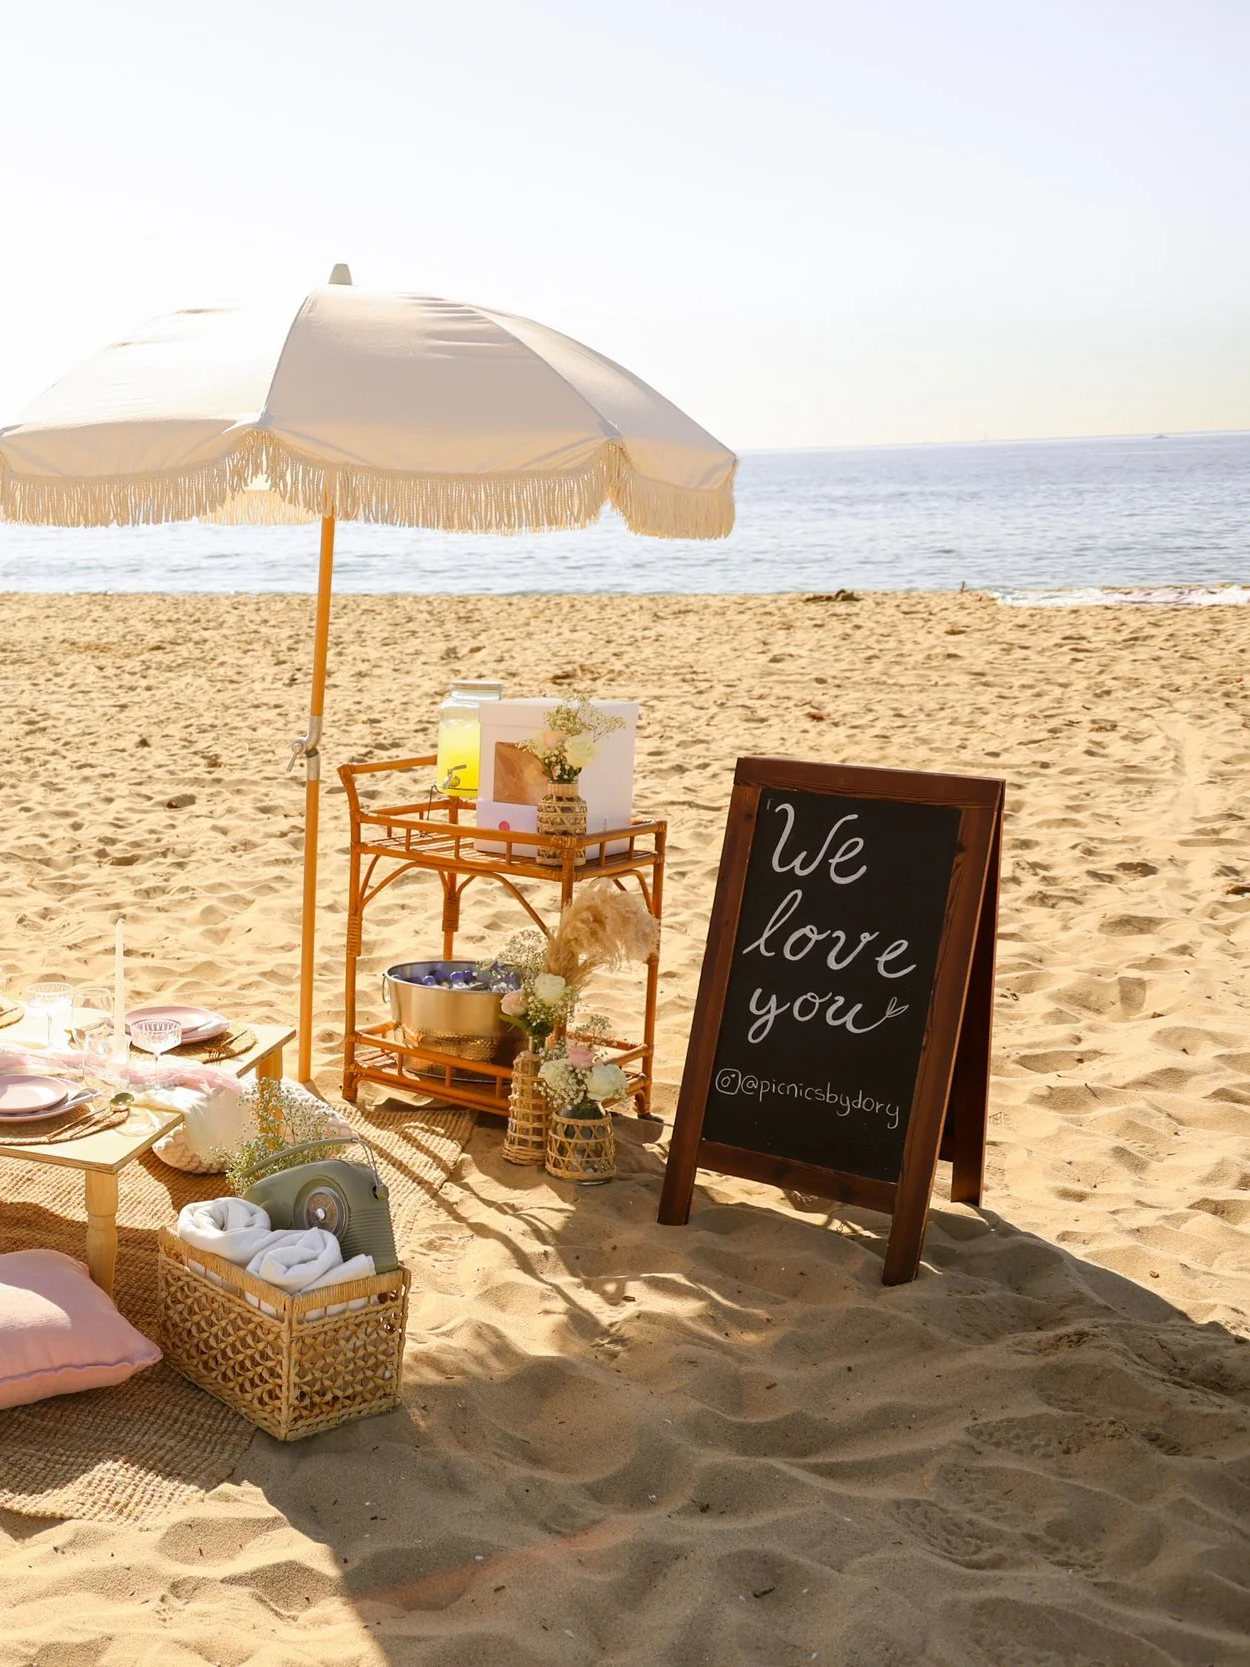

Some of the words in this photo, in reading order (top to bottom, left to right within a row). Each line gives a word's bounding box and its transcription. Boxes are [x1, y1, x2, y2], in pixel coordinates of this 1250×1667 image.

[770, 802, 868, 885] We
[742, 889, 917, 979] love
[747, 987, 896, 1044] you
[741, 1074, 900, 1130] @picnicsbydory
